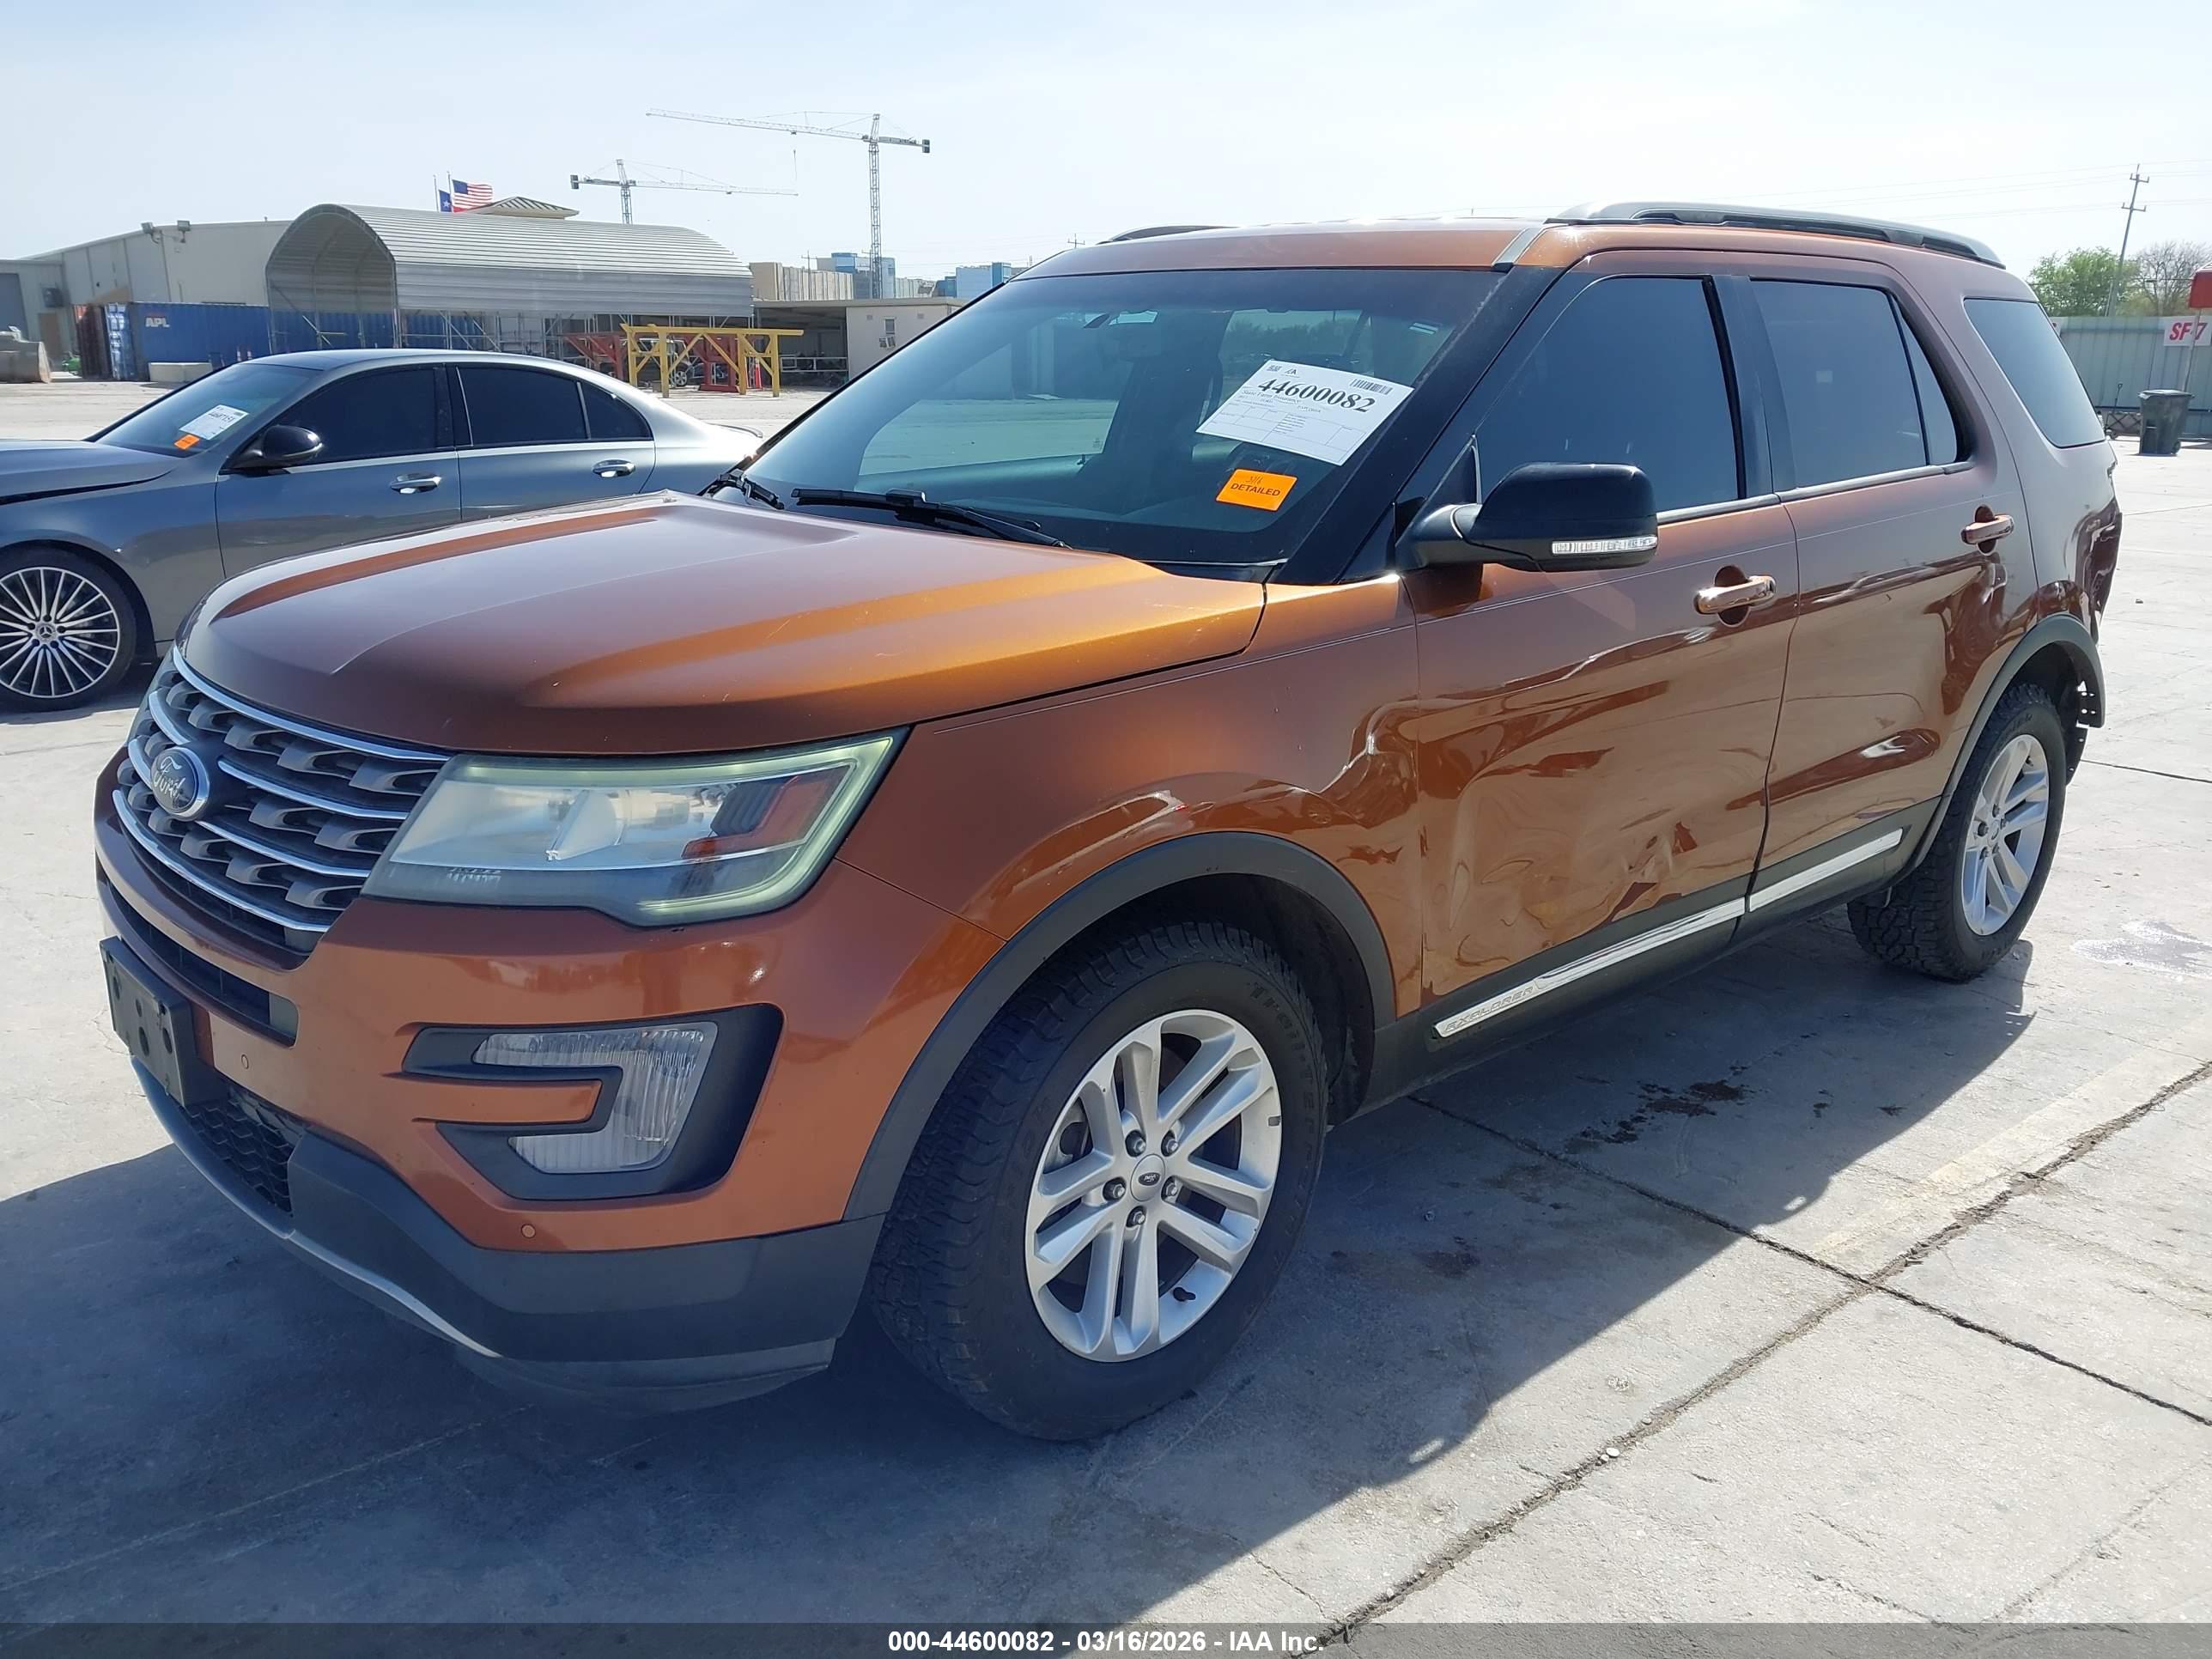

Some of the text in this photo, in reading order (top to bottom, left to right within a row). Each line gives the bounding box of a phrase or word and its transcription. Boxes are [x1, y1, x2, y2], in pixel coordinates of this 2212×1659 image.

[145, 317, 170, 327] APL
[1258, 379, 1376, 413] 44600082
[1231, 483, 1281, 496] DETAILED
[154, 756, 186, 798] Ford
